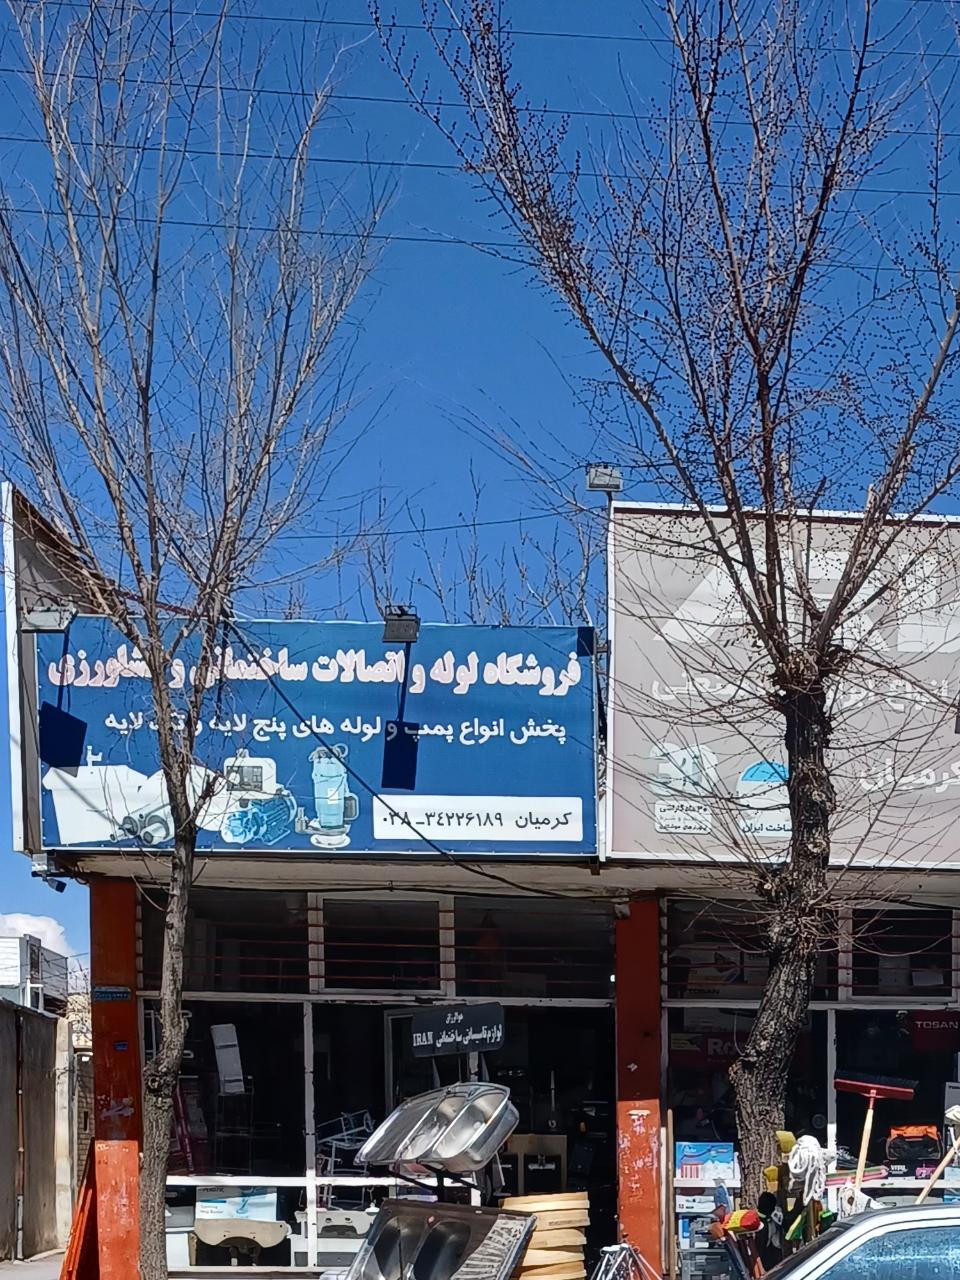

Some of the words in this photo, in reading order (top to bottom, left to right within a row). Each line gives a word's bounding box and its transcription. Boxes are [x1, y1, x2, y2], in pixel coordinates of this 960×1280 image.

[48, 643, 162, 688] شاورزی
[168, 658, 186, 689] و
[188, 647, 309, 688] ساختمانی
[312, 649, 405, 683] اتصالات
[430, 651, 479, 694] لوله
[483, 652, 582, 696] فروشگاه
[409, 663, 426, 694] و
[104, 711, 143, 735] لایه
[209, 712, 247, 736] لایه
[252, 716, 286, 741] پنج
[292, 714, 335, 738] های
[340, 716, 381, 742] لوله
[387, 723, 398, 740] و
[404, 721, 454, 743] پمپ
[459, 717, 504, 745] انواع
[510, 717, 567, 744] پخش
[515, 812, 572, 830] کرمیان
[766, 823, 793, 832] اخت
[914, 1020, 959, 1029] TOSAN
[412, 1031, 434, 1047] IRAN
